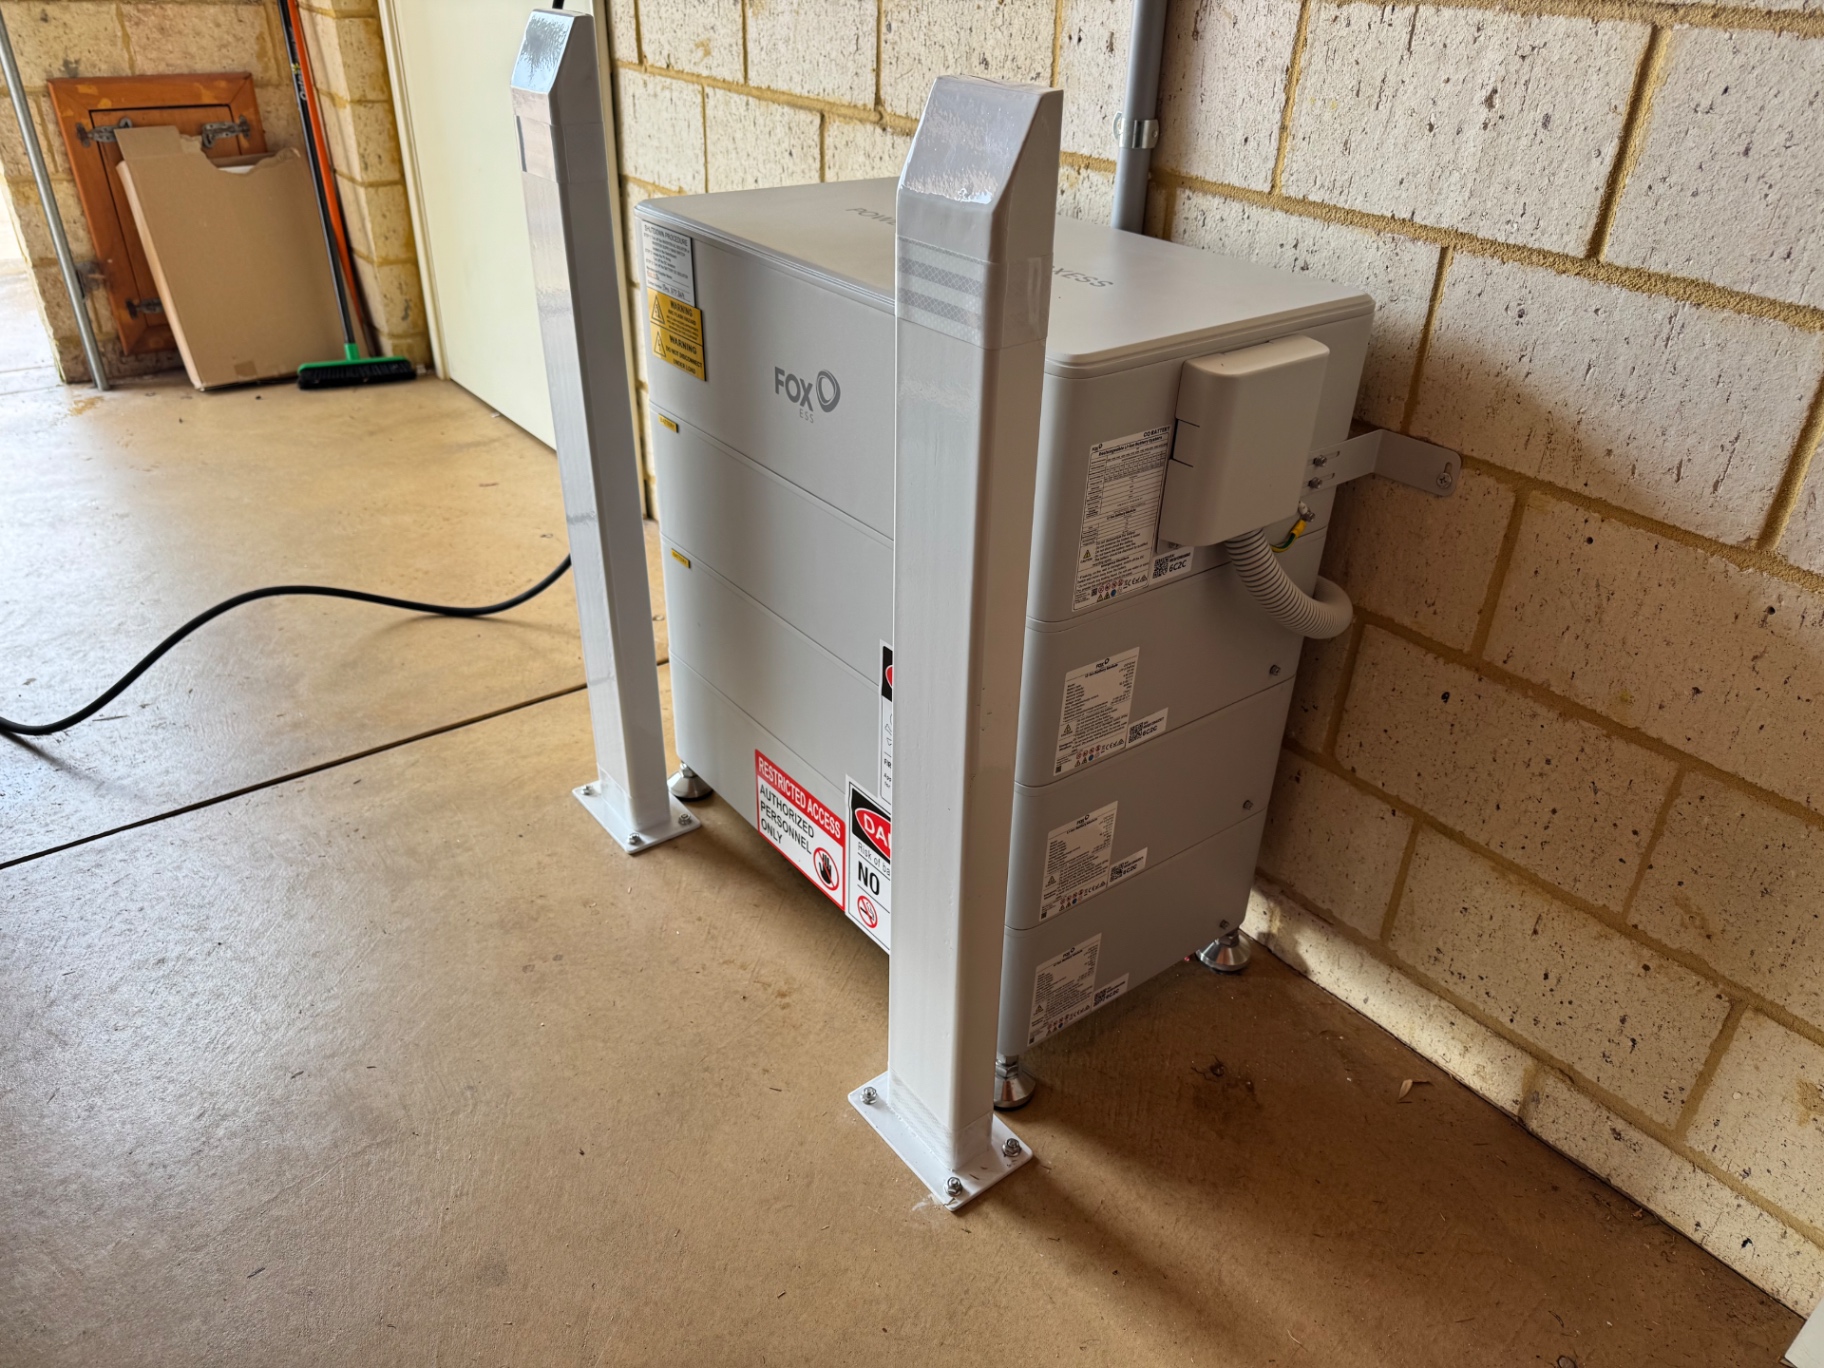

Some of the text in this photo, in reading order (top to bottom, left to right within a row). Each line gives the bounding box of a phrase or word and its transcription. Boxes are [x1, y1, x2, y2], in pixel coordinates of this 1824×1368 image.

[670, 300, 693, 317] WARNING
[669, 334, 697, 355] WARNING
[774, 366, 814, 412] FOX
[799, 408, 814, 424] ESS
[1168, 559, 1187, 572] 6C2C
[758, 756, 841, 839] RESTRICTED ACCESS
[759, 784, 815, 838] AUTHORIZED
[760, 800, 812, 855] PERSONNEL
[761, 818, 783, 844] ONLY
[857, 841, 872, 861] Risk
[873, 856, 881, 868] of
[857, 860, 880, 896] NO
